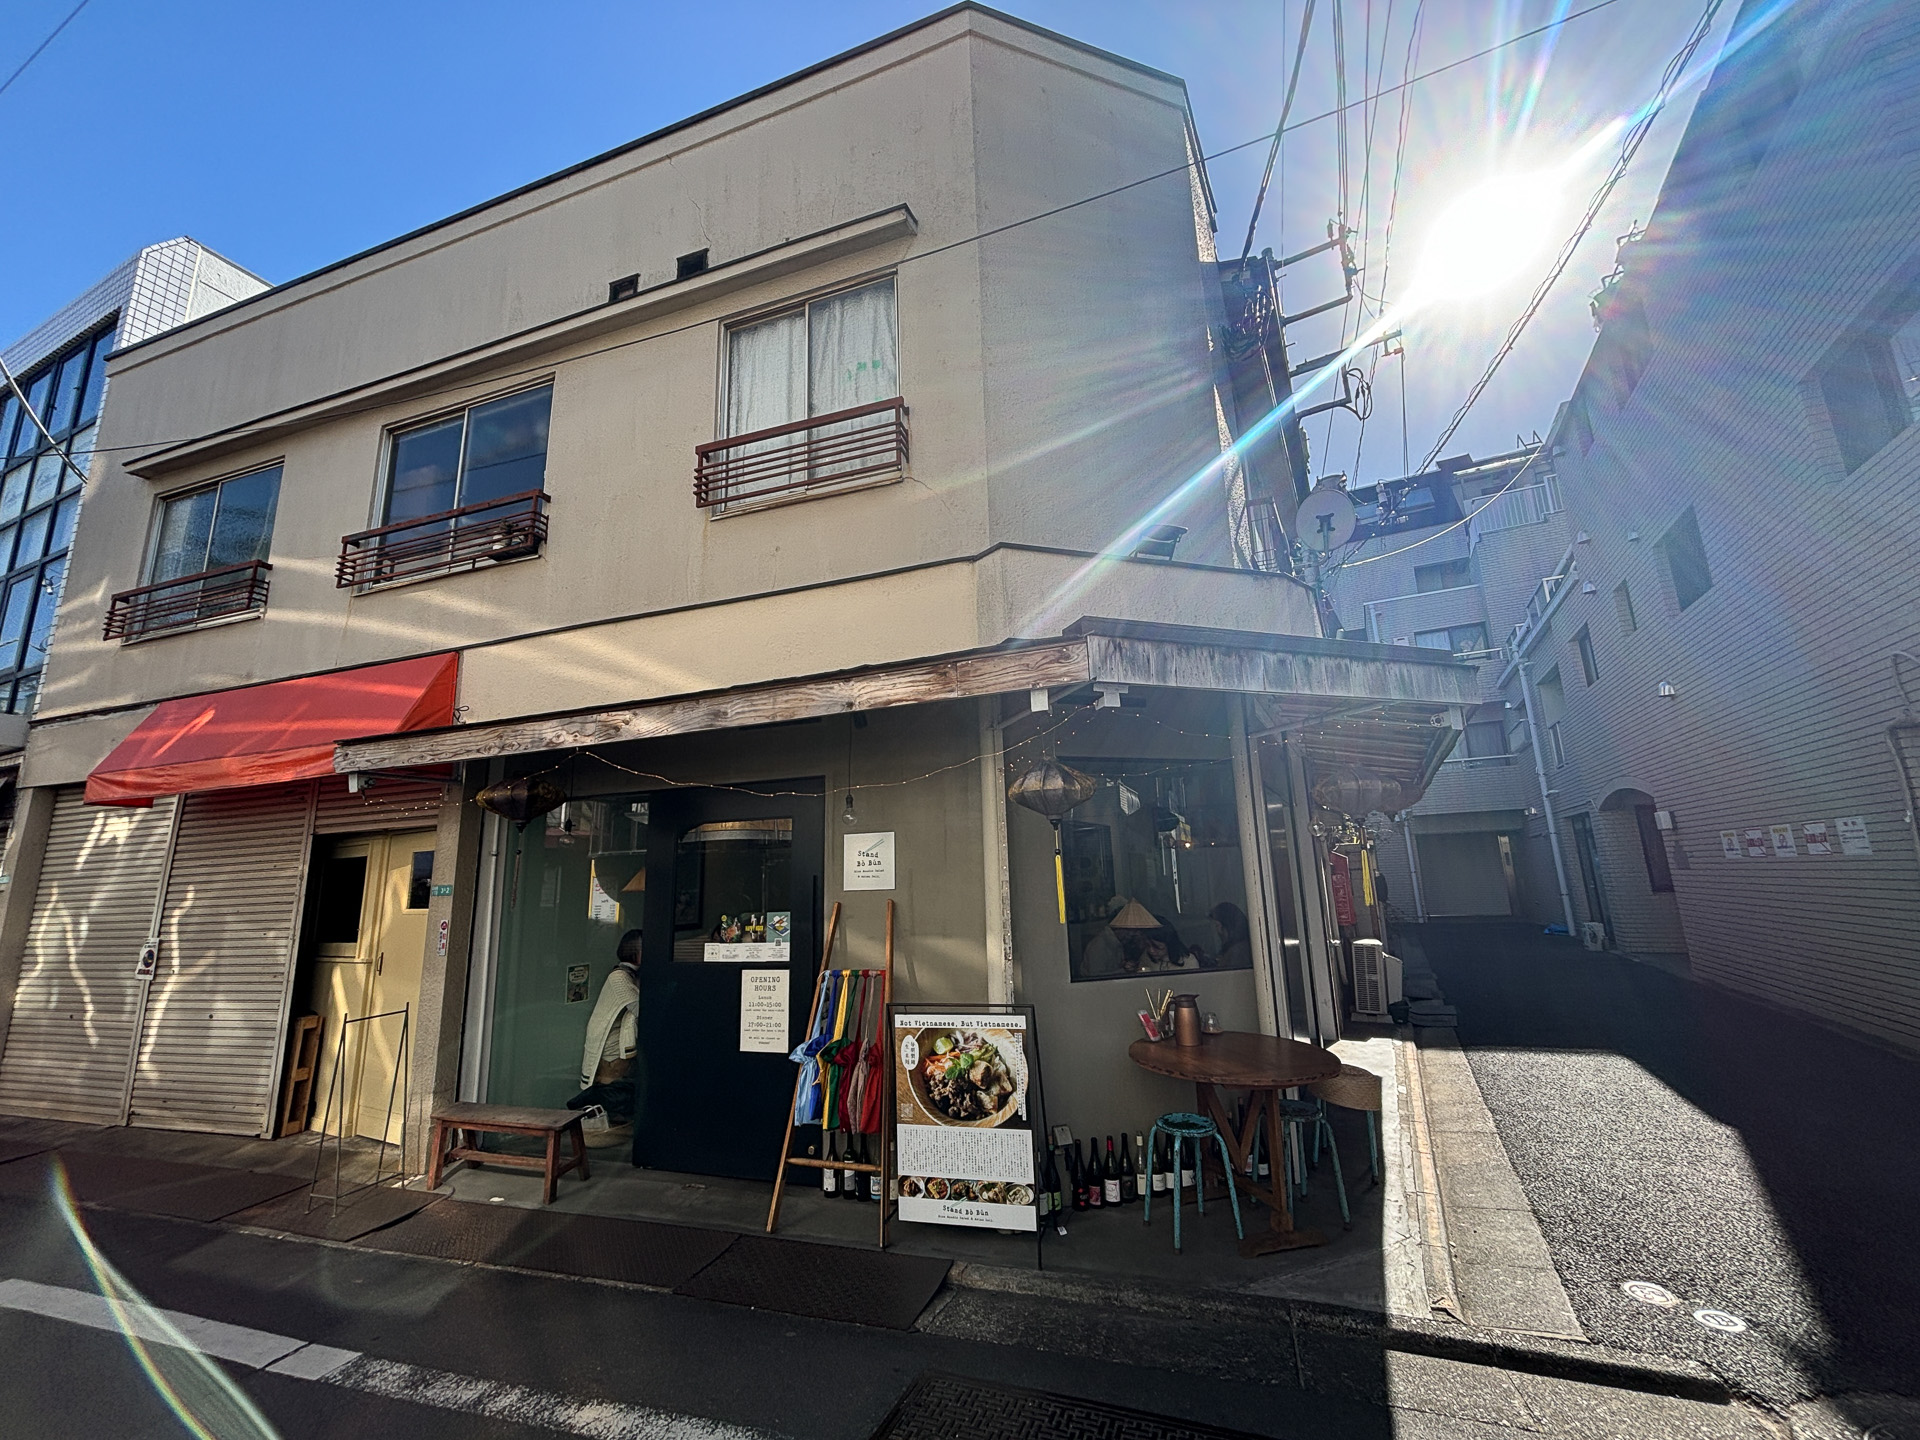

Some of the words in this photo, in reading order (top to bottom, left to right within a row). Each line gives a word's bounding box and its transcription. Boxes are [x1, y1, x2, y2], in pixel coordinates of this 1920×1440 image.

[857, 850, 879, 858] Stand
[754, 984, 777, 992] HOURS
[914, 1020, 958, 1028] Vietnamese,
[975, 1020, 1022, 1028] Vietnamese.
[942, 1204, 963, 1215] Stand
